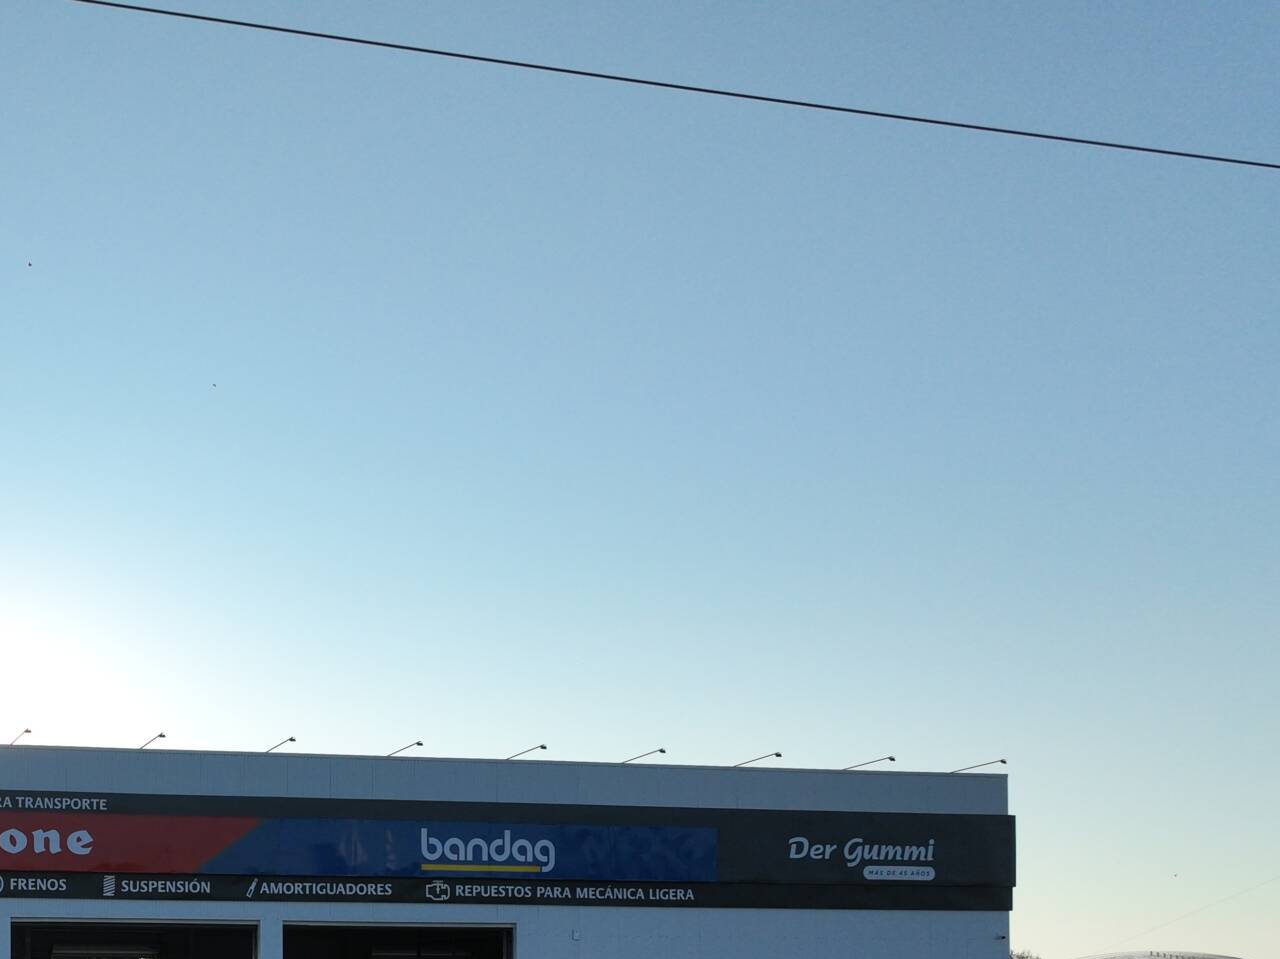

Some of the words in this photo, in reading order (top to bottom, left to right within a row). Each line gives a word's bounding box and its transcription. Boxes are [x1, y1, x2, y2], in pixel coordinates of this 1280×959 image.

[16, 796, 108, 811] TRANSPORTE
[420, 827, 554, 873] bandag
[789, 837, 837, 859] Der
[844, 838, 935, 867] Gummi
[10, 877, 67, 892] FRENOS
[121, 876, 211, 894] SUSPENSIÓN
[260, 881, 393, 897] AMORTIGUADORES
[455, 884, 532, 899] REPUESTOS
[537, 886, 572, 899] PARA
[576, 885, 645, 901] MECÁNICA
[650, 888, 695, 902] LIGERA
